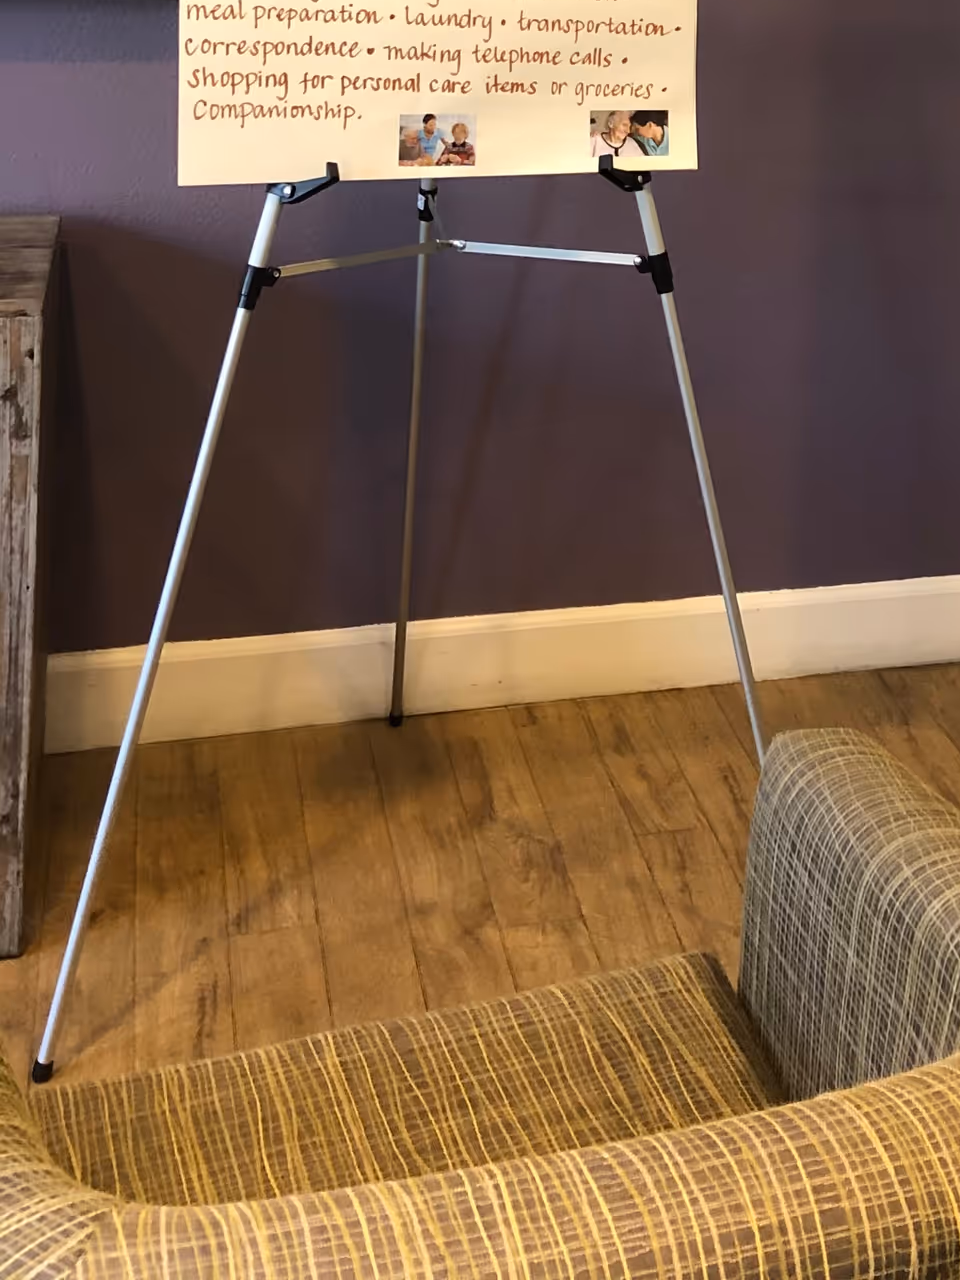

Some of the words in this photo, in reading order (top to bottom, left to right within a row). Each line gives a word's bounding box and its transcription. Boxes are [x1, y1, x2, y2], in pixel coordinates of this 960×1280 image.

[187, 0, 245, 21] meal
[252, 4, 383, 29] preparation
[405, 5, 492, 43] laundry
[517, 10, 670, 43] transportation
[383, 42, 461, 76] making
[472, 44, 562, 72] telephone
[570, 48, 612, 67] calls
[299, 72, 334, 94] for
[341, 73, 420, 96] personal
[429, 79, 472, 94] care
[486, 74, 538, 95] items
[551, 81, 568, 95] or
[575, 82, 653, 106] groceries
